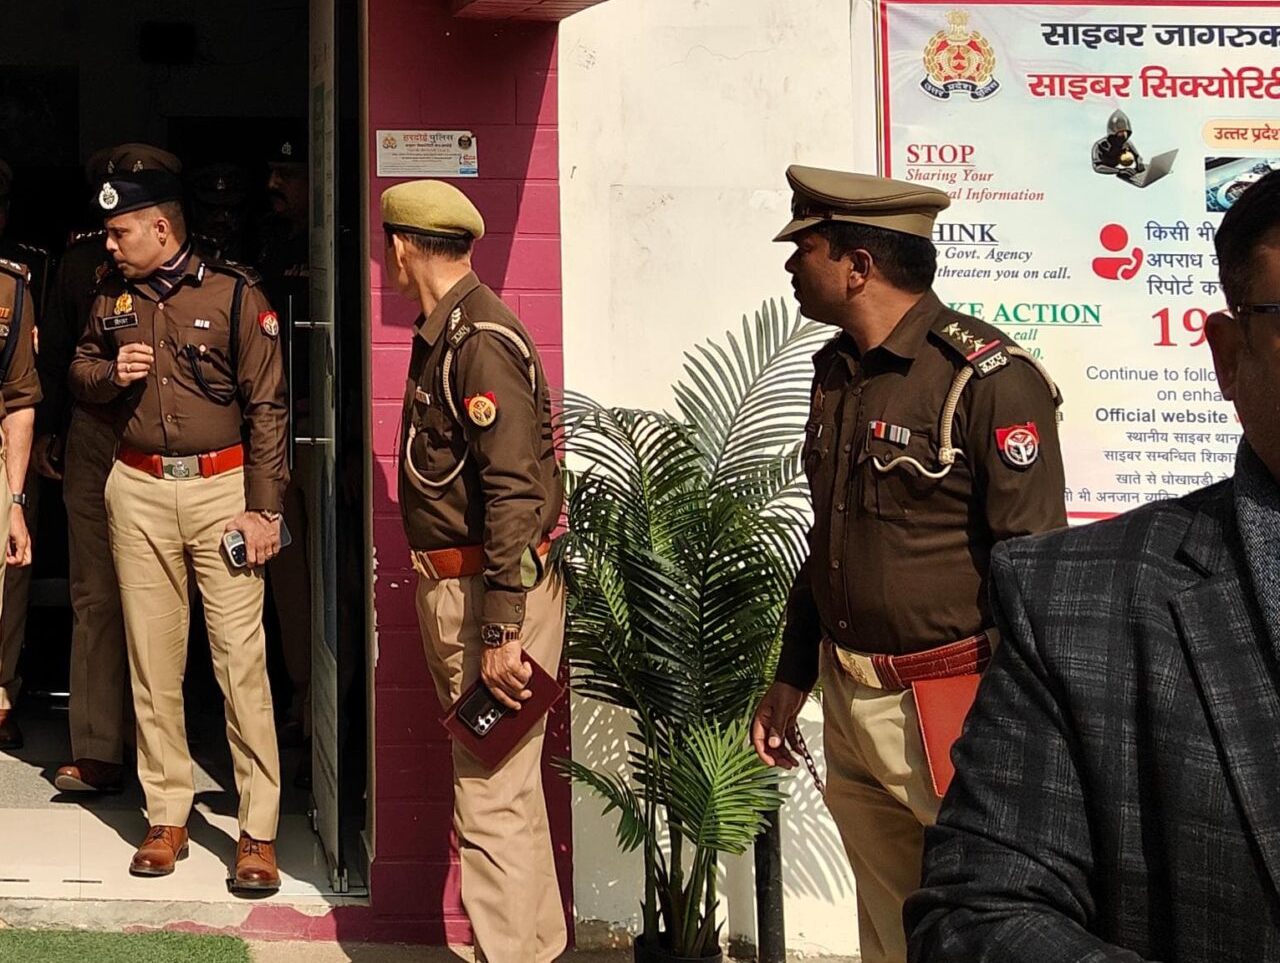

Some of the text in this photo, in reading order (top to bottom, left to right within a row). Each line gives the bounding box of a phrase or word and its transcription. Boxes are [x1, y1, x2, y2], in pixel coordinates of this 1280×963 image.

[1041, 23, 1147, 49] साइबर
[1028, 74, 1133, 100] साइबर
[907, 144, 974, 164] STOP
[906, 169, 993, 184] Sharing Your
[966, 188, 1044, 203] Information
[1145, 221, 1189, 241] किसी
[945, 247, 980, 259] Govt.
[985, 248, 1032, 262] Agency
[1147, 253, 1203, 268] अपराध
[994, 268, 1019, 281] you
[1023, 269, 1039, 279] on
[1043, 267, 1071, 279] call.
[1146, 275, 1193, 295] रिपोर्ट
[992, 303, 1102, 323] ACTION
[1014, 329, 1037, 340] call
[1086, 366, 1179, 381] Continue to
[1157, 390, 1177, 401] on
[1096, 408, 1155, 422] Official
[1162, 409, 1228, 423] website
